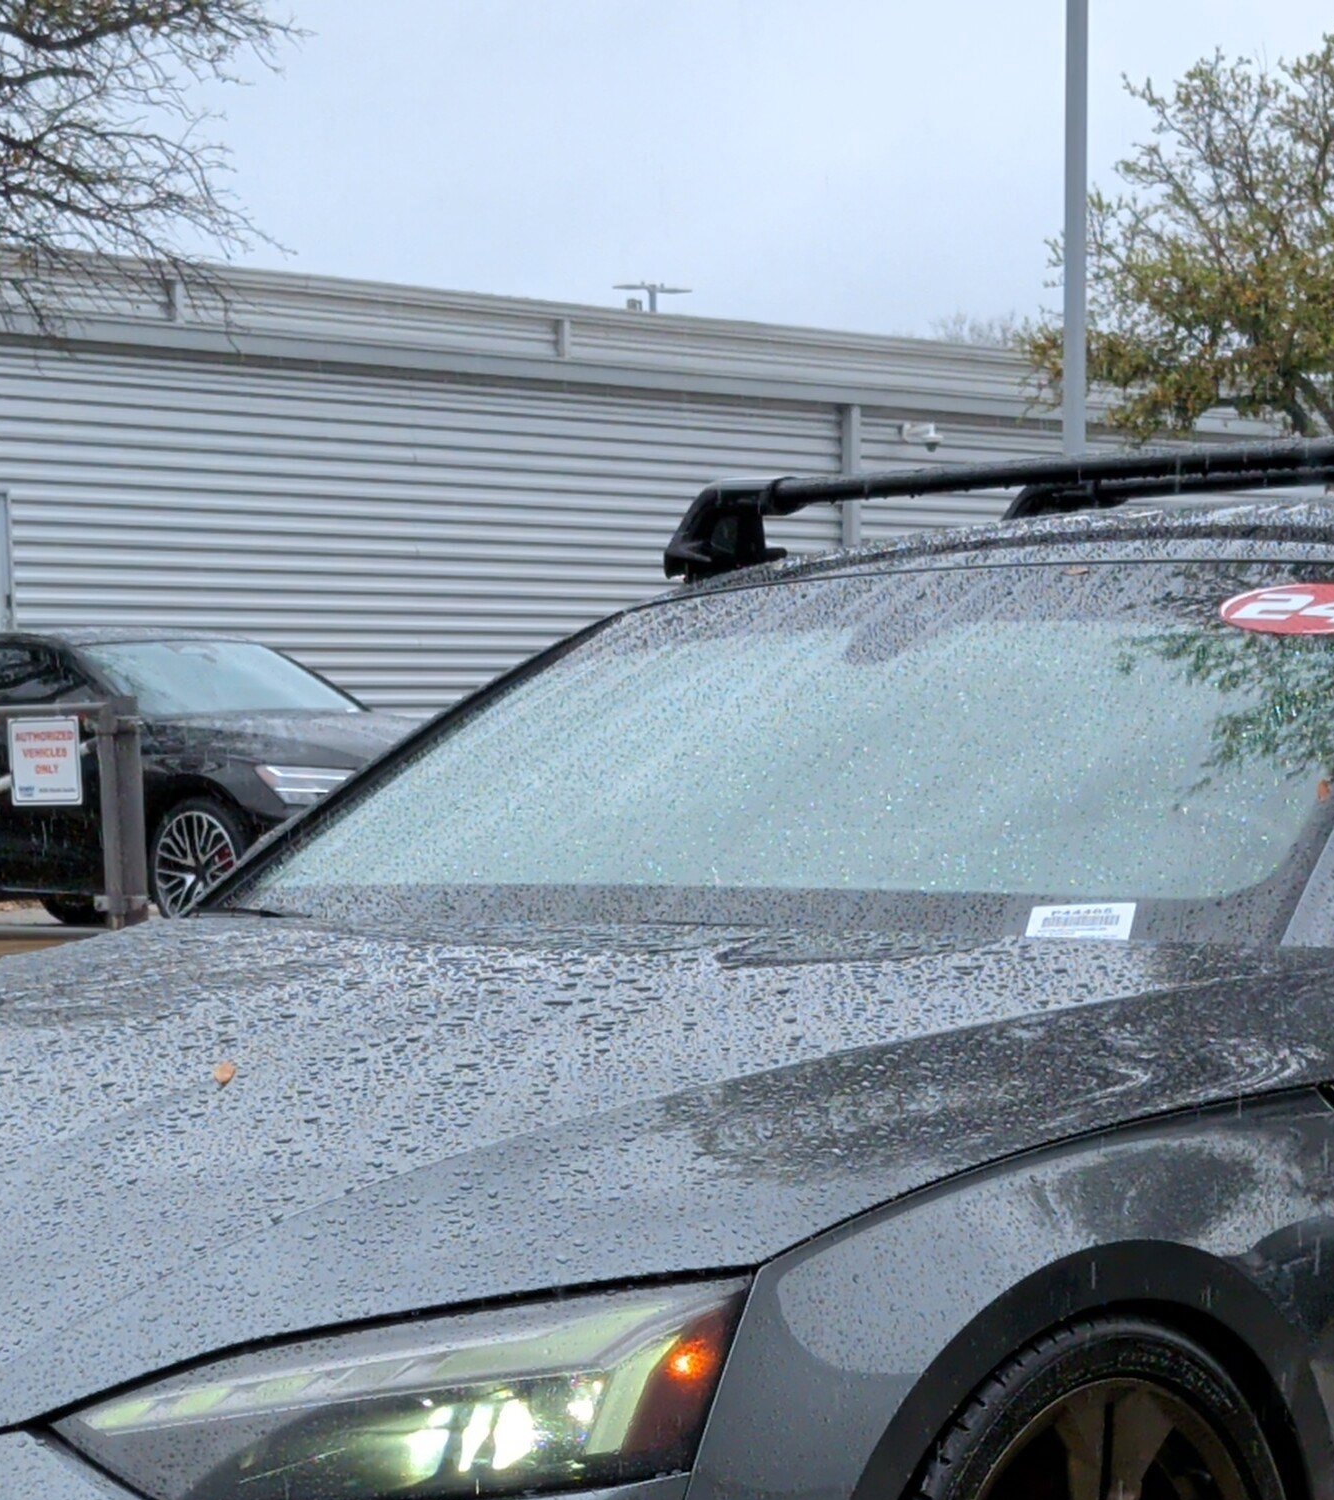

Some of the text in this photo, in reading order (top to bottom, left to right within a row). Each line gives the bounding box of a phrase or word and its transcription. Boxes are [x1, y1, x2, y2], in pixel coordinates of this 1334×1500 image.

[15, 730, 74, 741] AUTHORIZED
[22, 747, 67, 758] VEHICLES
[35, 764, 58, 774] ONLY
